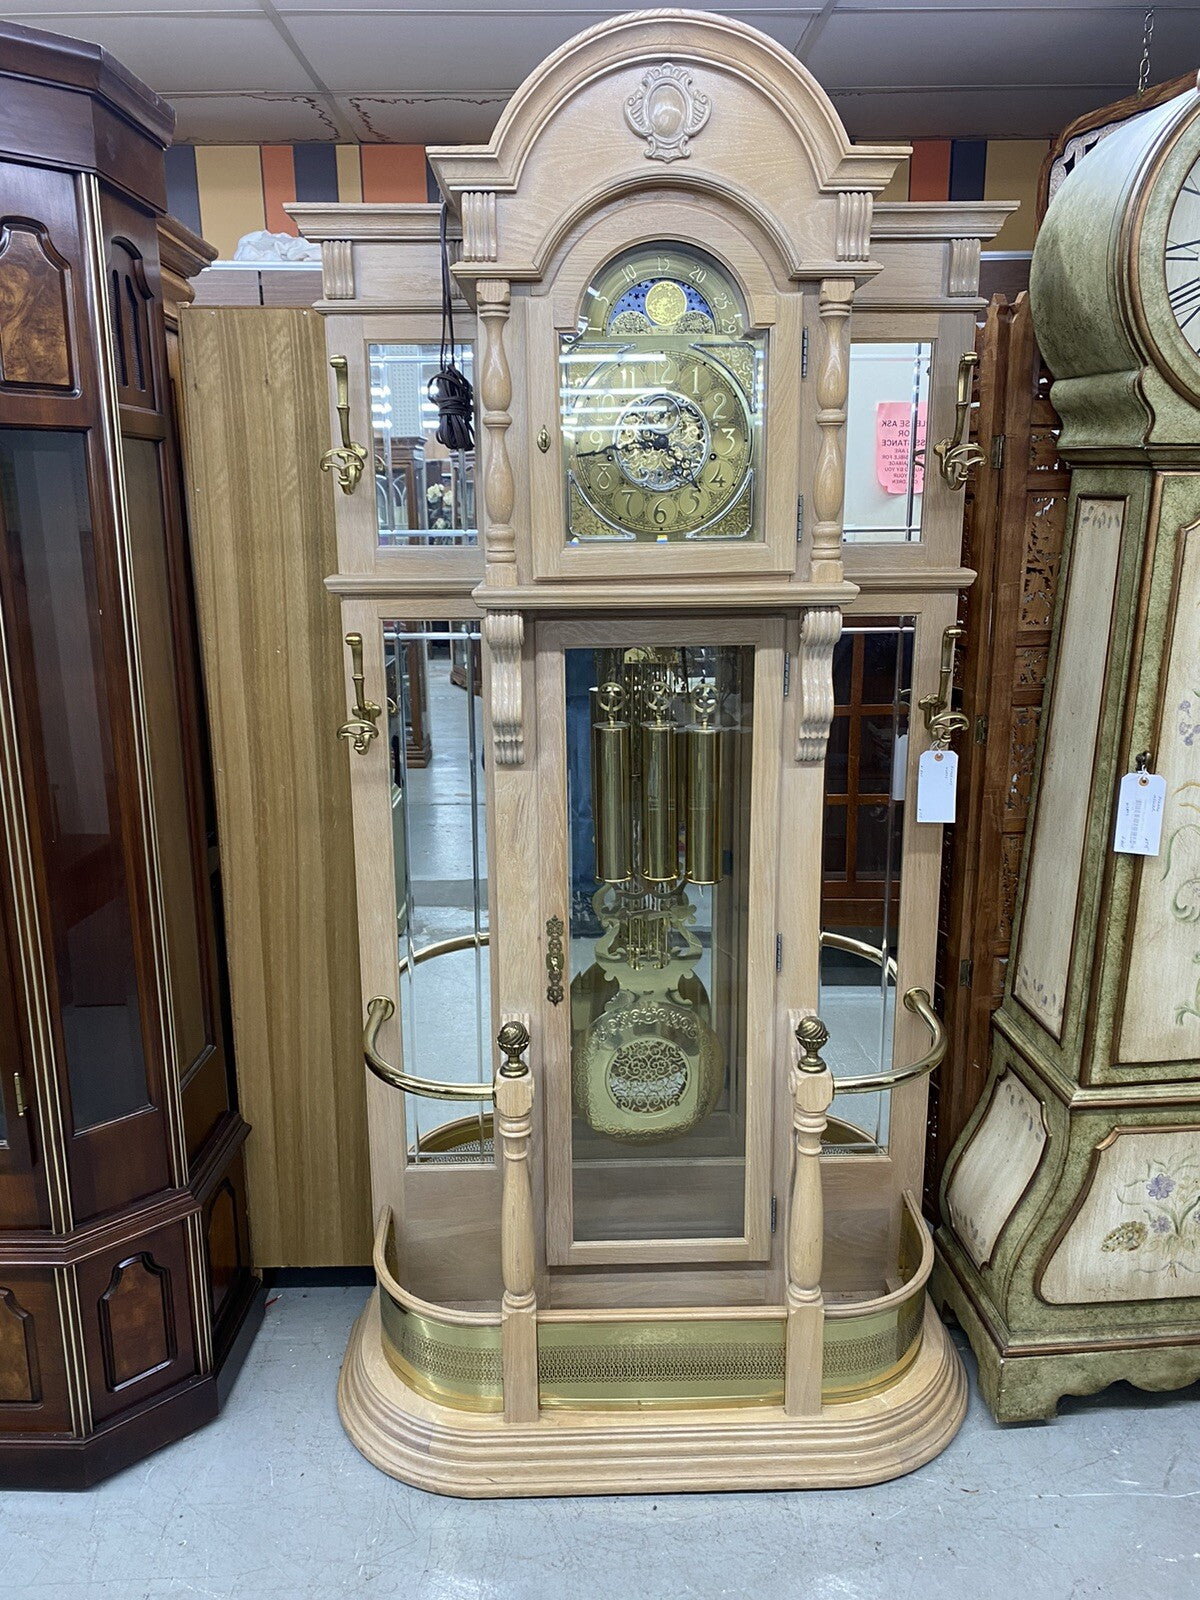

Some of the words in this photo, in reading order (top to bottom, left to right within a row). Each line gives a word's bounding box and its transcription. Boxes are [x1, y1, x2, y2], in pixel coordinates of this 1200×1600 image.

[621, 264, 637, 282] 10
[657, 255, 671, 271] 15
[688, 265, 707, 283] 20
[714, 292, 733, 310] 25
[721, 316, 737, 334] 29
[620, 366, 636, 390] 11
[651, 357, 675, 385] 12
[691, 366, 700, 394] 1
[713, 392, 728, 419] 2
[589, 429, 604, 453] 9
[721, 427, 736, 456] 3
[596, 462, 612, 490] 8
[709, 463, 726, 488] 4
[621, 489, 637, 517] 7
[653, 497, 668, 524] 6
[687, 487, 700, 515] 5
